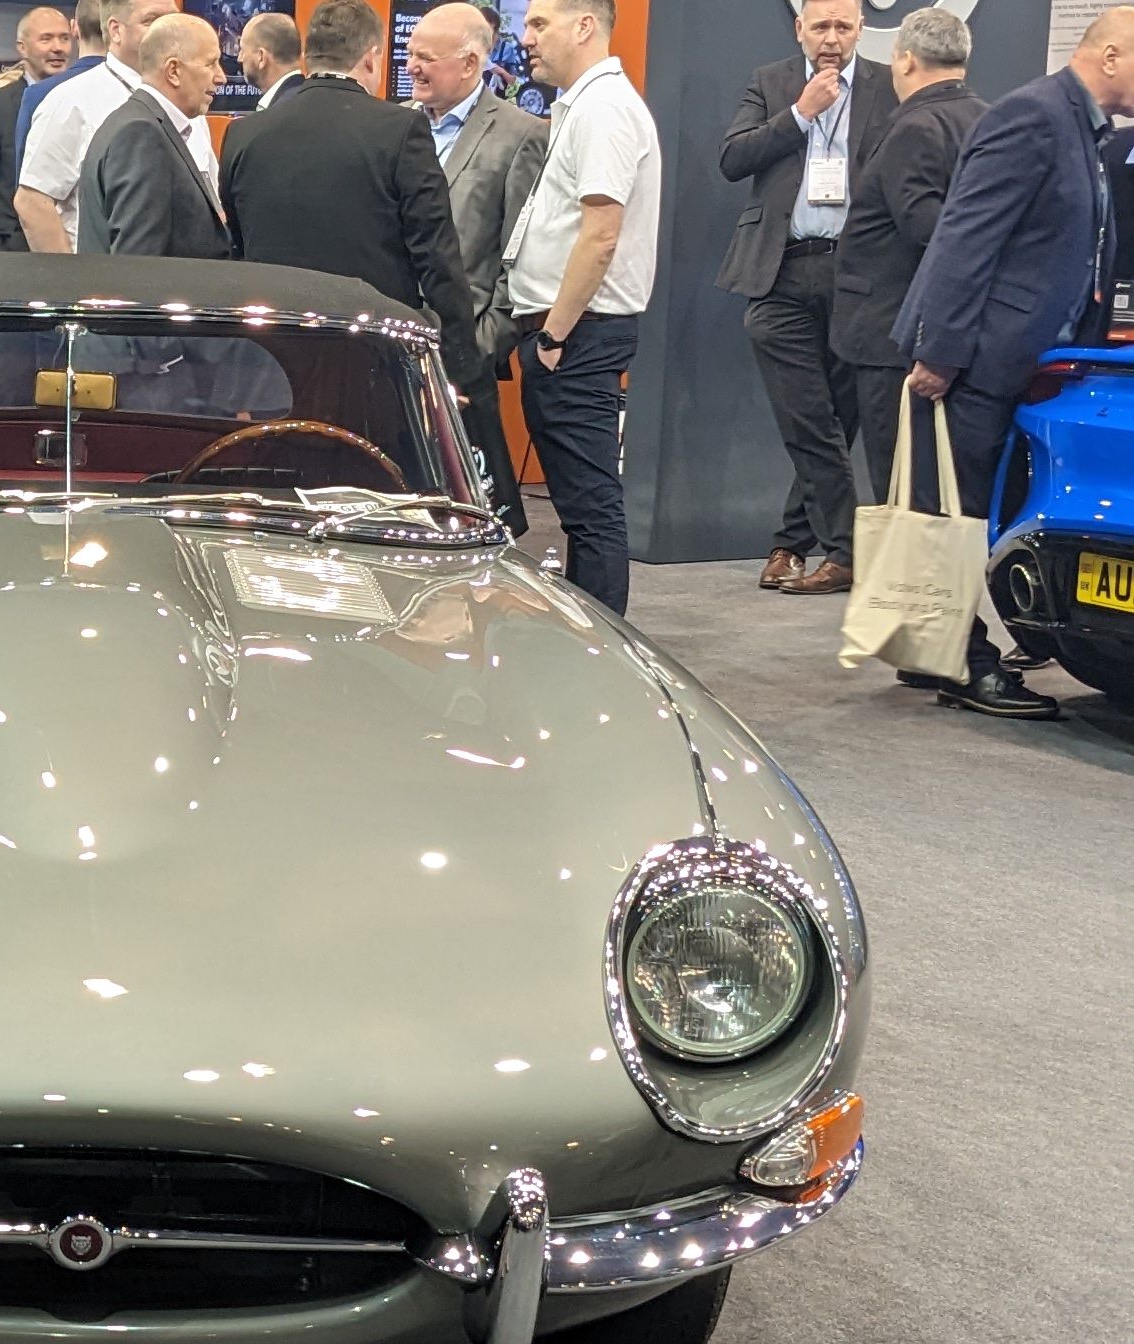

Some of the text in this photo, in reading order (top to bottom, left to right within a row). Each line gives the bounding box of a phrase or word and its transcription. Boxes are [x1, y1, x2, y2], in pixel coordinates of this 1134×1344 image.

[396, 13, 422, 23] Becom
[226, 85, 233, 95] OF
[235, 85, 247, 95] THE
[1096, 561, 1134, 603] AU
